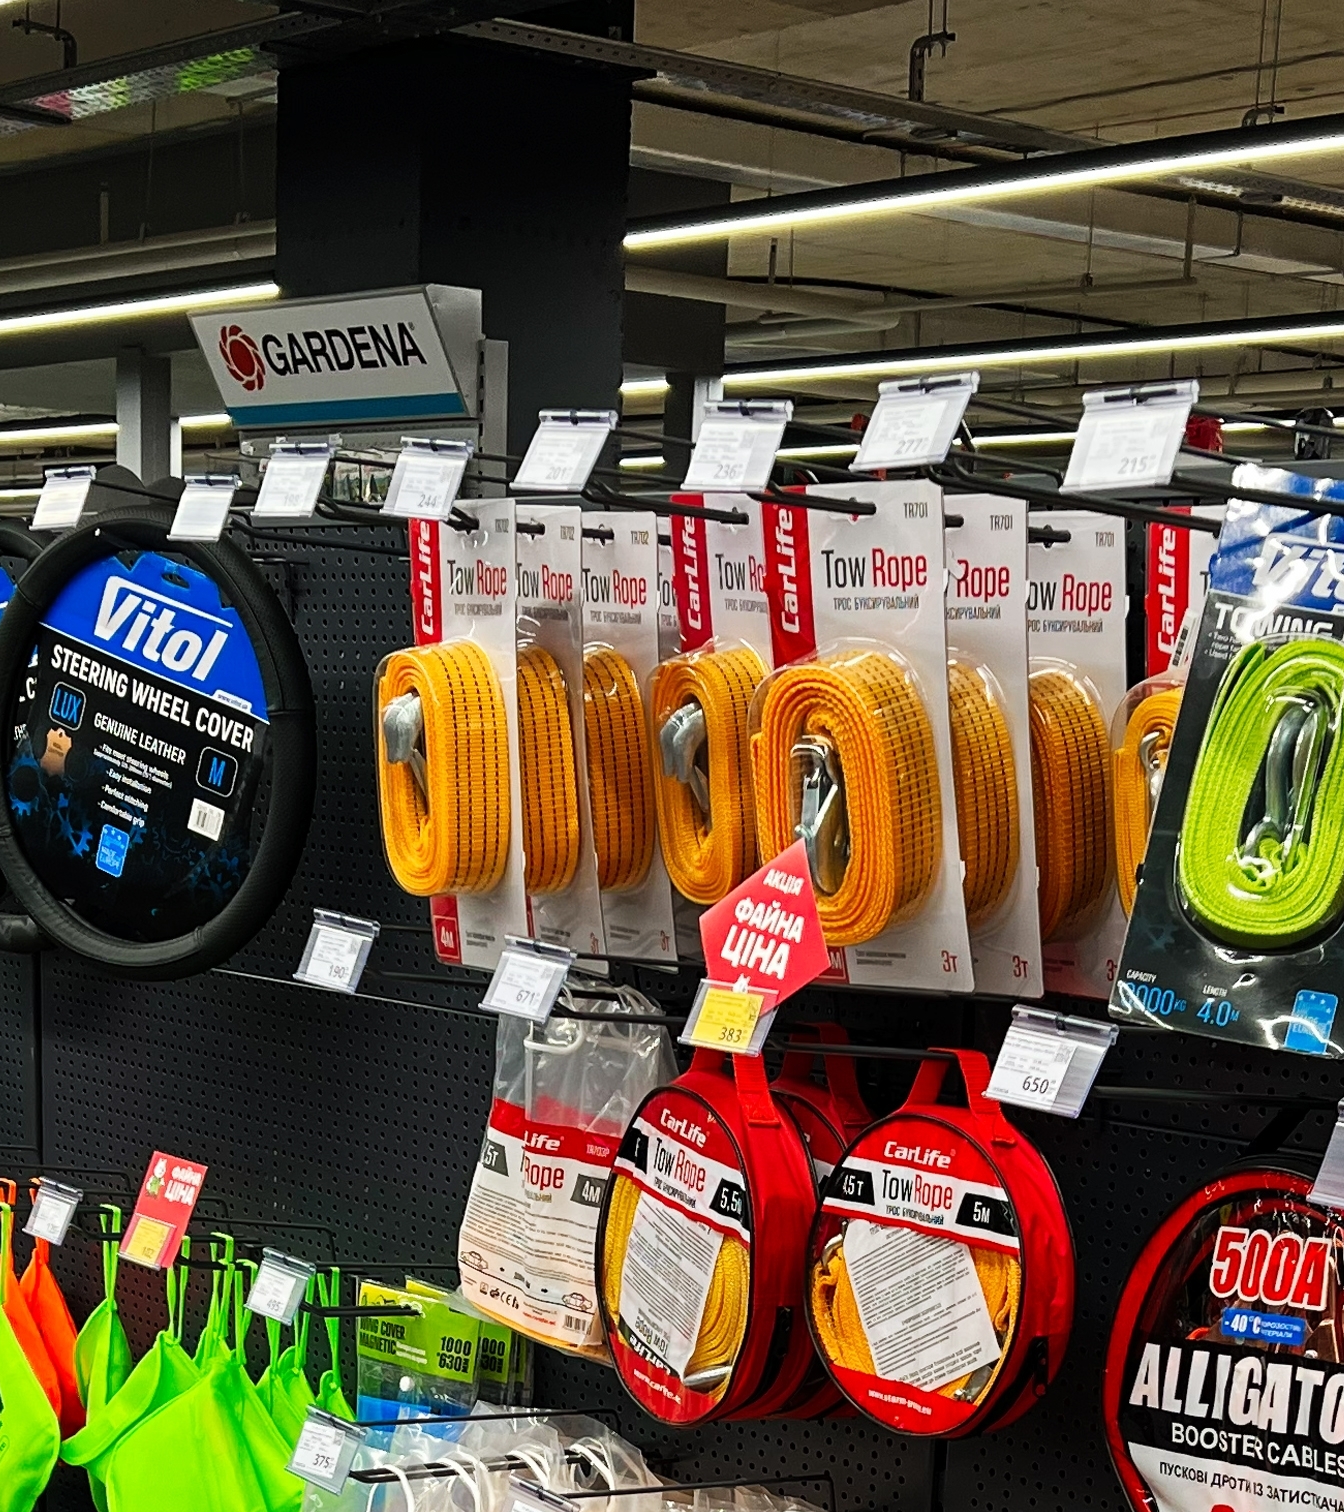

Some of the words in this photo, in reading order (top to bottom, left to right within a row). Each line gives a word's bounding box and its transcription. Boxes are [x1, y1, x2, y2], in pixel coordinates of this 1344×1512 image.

[262, 322, 427, 376] GARDENA
[1119, 457, 1147, 474] 215
[903, 502, 929, 519] TR701
[990, 514, 1014, 531] TR701
[420, 519, 434, 636] CarLife
[447, 559, 476, 596] Tow
[476, 558, 508, 602] Rope
[582, 567, 611, 604] Tow
[613, 569, 647, 608] Rope
[775, 508, 801, 634] CarLife
[821, 549, 866, 589] Tow
[873, 547, 929, 591] Rope
[94, 575, 233, 681] Vitol
[51, 644, 128, 698] STEERING
[132, 679, 191, 727] WHEEL
[195, 707, 255, 753] COVER
[53, 687, 81, 724] LUX
[94, 712, 138, 745] GENUINE
[139, 729, 187, 766] LEATHER
[208, 757, 226, 788] M
[761, 868, 803, 896] АКЦІЯ
[733, 898, 804, 944] ФАЙНА
[721, 925, 792, 981] ЦІНА
[719, 1026, 742, 1044] 383
[1022, 1075, 1050, 1095] 650
[660, 1108, 706, 1148] CarLife
[655, 1137, 675, 1174] Tow
[675, 1146, 706, 1193] Rope
[884, 1141, 952, 1169] CarLife
[164, 1180, 196, 1206] ЦІНА
[881, 1169, 912, 1201] Tow
[913, 1180, 954, 1212] Rope
[1209, 1226, 1332, 1311] 500A
[441, 1336, 472, 1356] 1000
[1171, 1422, 1263, 1460] BOOSTER
[312, 1453, 331, 1470] 375
[1159, 1461, 1208, 1485] ПУСКОВІ
[1210, 1473, 1251, 1493] ДРОТИ
